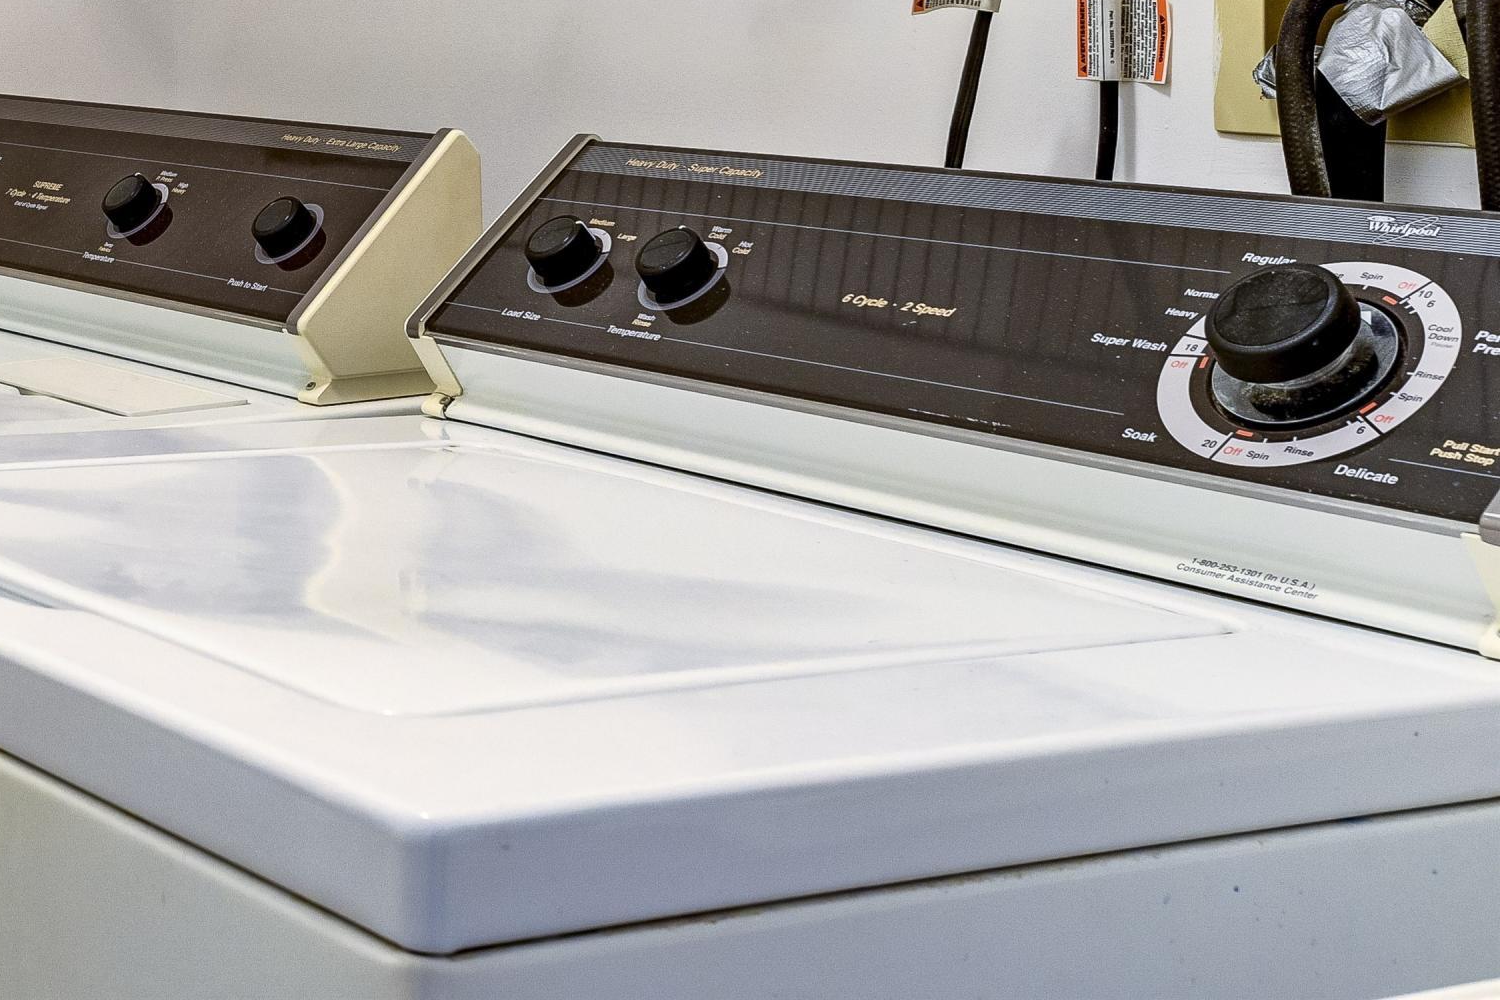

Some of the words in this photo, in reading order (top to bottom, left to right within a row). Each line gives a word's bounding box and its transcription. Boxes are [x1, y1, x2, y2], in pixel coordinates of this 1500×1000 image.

[281, 134, 304, 143] Heavy
[304, 135, 321, 145] Duty
[325, 137, 346, 147] Extra
[346, 139, 368, 150] Large
[368, 141, 401, 153] Capacity
[625, 158, 655, 169] Heavy
[655, 160, 680, 171] Duty
[687, 163, 717, 174] Super
[719, 166, 764, 179] Capacity
[32, 180, 64, 191] SUPREME
[10, 189, 27, 198] Cycle
[36, 192, 71, 205] Temperature
[589, 217, 616, 227] Medium
[711, 225, 733, 234] Warm
[1368, 217, 1442, 240] Whirlpool
[617, 232, 638, 242] Large
[708, 232, 728, 240] Cold
[738, 240, 754, 248] Hot
[731, 247, 752, 255] Cold
[82, 251, 115, 264] Temperature
[1241, 252, 1298, 266] Regular
[1360, 271, 1385, 281] Spin
[227, 277, 244, 288] Push
[243, 281, 251, 289] to
[251, 282, 268, 292] Start
[1398, 280, 1418, 291] Off
[1184, 288, 1221, 300] Norma
[1418, 290, 1434, 299] 10
[841, 293, 855, 303] 6
[852, 295, 889, 307] Cycle
[900, 301, 915, 311] 2
[911, 303, 957, 317] Speed
[1426, 299, 1437, 308] 6
[501, 308, 522, 319] Load
[522, 311, 542, 321] Size
[1164, 307, 1200, 320] Heavy
[606, 325, 662, 343] Temperature
[1427, 323, 1454, 333] Cool
[1090, 332, 1131, 347] Super
[1131, 338, 1169, 352] Wash
[1427, 332, 1460, 343] Down
[1184, 343, 1199, 352] 18
[1169, 359, 1190, 369] Off
[1414, 370, 1446, 381] Rinse
[1397, 392, 1423, 403] Spin
[1373, 414, 1395, 424] Off
[1121, 427, 1157, 443] Soak
[1356, 425, 1366, 435] 6
[1200, 439, 1218, 449] 20
[1443, 439, 1470, 451] Pull
[1222, 446, 1243, 457] Off
[1245, 450, 1270, 461] Spin
[1283, 445, 1315, 457] Rinse
[1429, 447, 1463, 460] Push
[1464, 453, 1495, 466] Stop
[1334, 464, 1399, 485] Delicate
[1191, 557, 1263, 579] 1-800-253-1301
[1263, 570, 1278, 582] (In
[1176, 562, 1225, 579] Consumer
[1226, 574, 1282, 592] Assistance
[1283, 586, 1319, 600] Center
